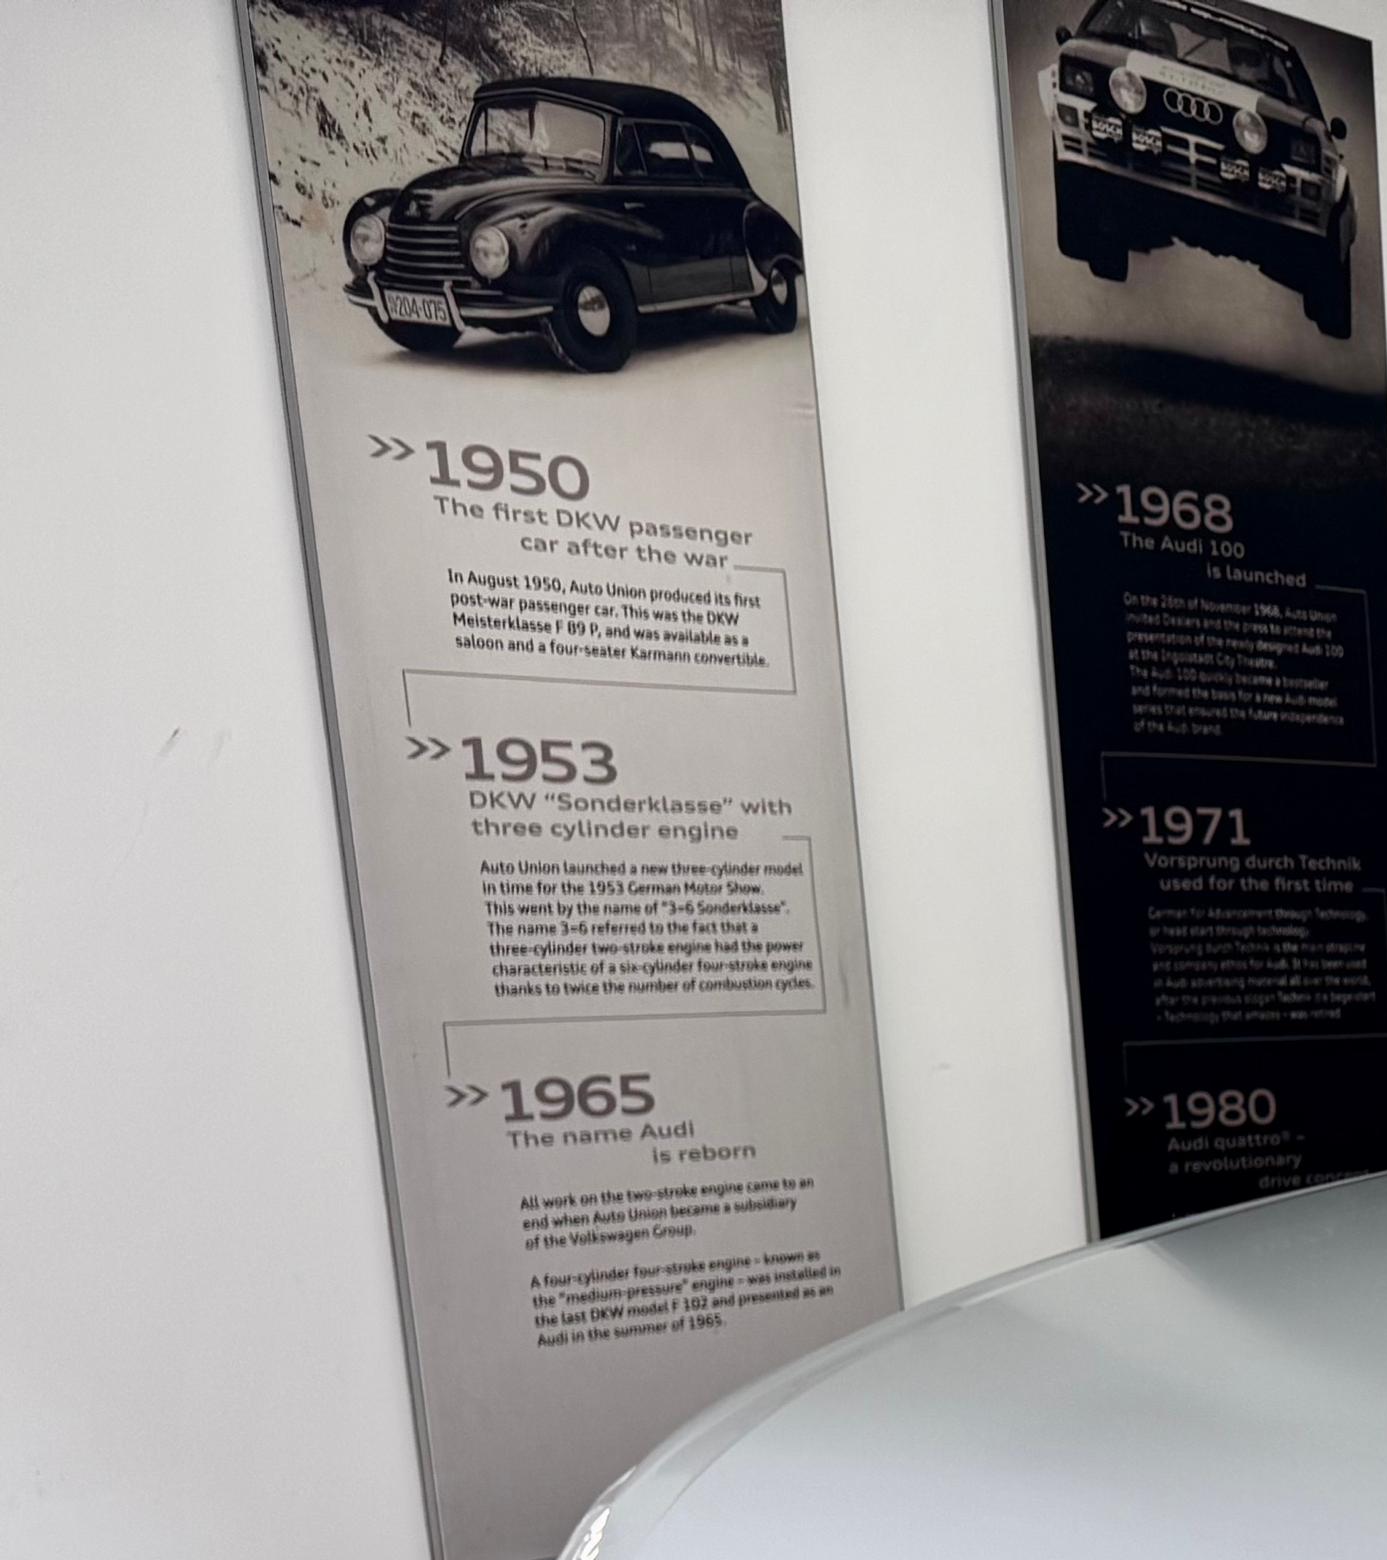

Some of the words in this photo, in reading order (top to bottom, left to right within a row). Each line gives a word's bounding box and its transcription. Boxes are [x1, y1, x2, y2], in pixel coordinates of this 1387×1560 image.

[425, 440, 590, 502] 1950
[433, 494, 484, 519] The
[492, 502, 548, 526] first
[555, 508, 620, 532] DKW
[628, 520, 752, 548] passenger
[1115, 484, 1233, 533] 1968
[520, 536, 558, 553] car
[566, 538, 628, 560] after
[635, 544, 677, 564] the
[683, 552, 728, 568] war
[1119, 530, 1155, 550] The
[1160, 535, 1203, 554] Audi
[1210, 539, 1245, 559] 100
[447, 567, 464, 584] In
[467, 570, 519, 591] August
[524, 575, 566, 595] 1950,
[569, 579, 603, 596] Auto
[606, 582, 647, 599] Union
[649, 588, 711, 605] produced
[714, 592, 731, 606] its
[733, 592, 760, 609] first
[1206, 562, 1221, 579] is
[1225, 564, 1307, 588] launched
[450, 592, 514, 616] post-war
[518, 598, 589, 618] passenger
[594, 605, 618, 618] car.
[621, 604, 650, 620] This
[652, 610, 678, 622] was
[681, 608, 703, 624] the
[706, 610, 739, 626] DKW
[452, 611, 552, 634] Meisterklasse
[605, 624, 630, 639] and
[633, 628, 660, 641] was
[663, 629, 721, 645] available
[724, 634, 738, 646] as
[741, 636, 749, 647] a
[455, 633, 504, 651] saloon
[507, 638, 534, 653] and
[538, 642, 546, 654] a
[549, 639, 626, 659] four-seater
[630, 645, 691, 663] Karmann
[461, 736, 617, 785] 1953
[1140, 805, 1250, 845] 1971
[1143, 851, 1240, 873] Vorsprung
[1244, 854, 1295, 870] durch
[1298, 854, 1361, 871] Technik
[1159, 875, 1203, 891] used
[1208, 874, 1235, 891] for
[1239, 876, 1269, 891] the
[1273, 876, 1310, 892] first
[1314, 877, 1354, 893] time
[500, 1073, 655, 1123] 1965
[1163, 1088, 1276, 1129] 1980
[1258, 1173, 1302, 1190] drive
